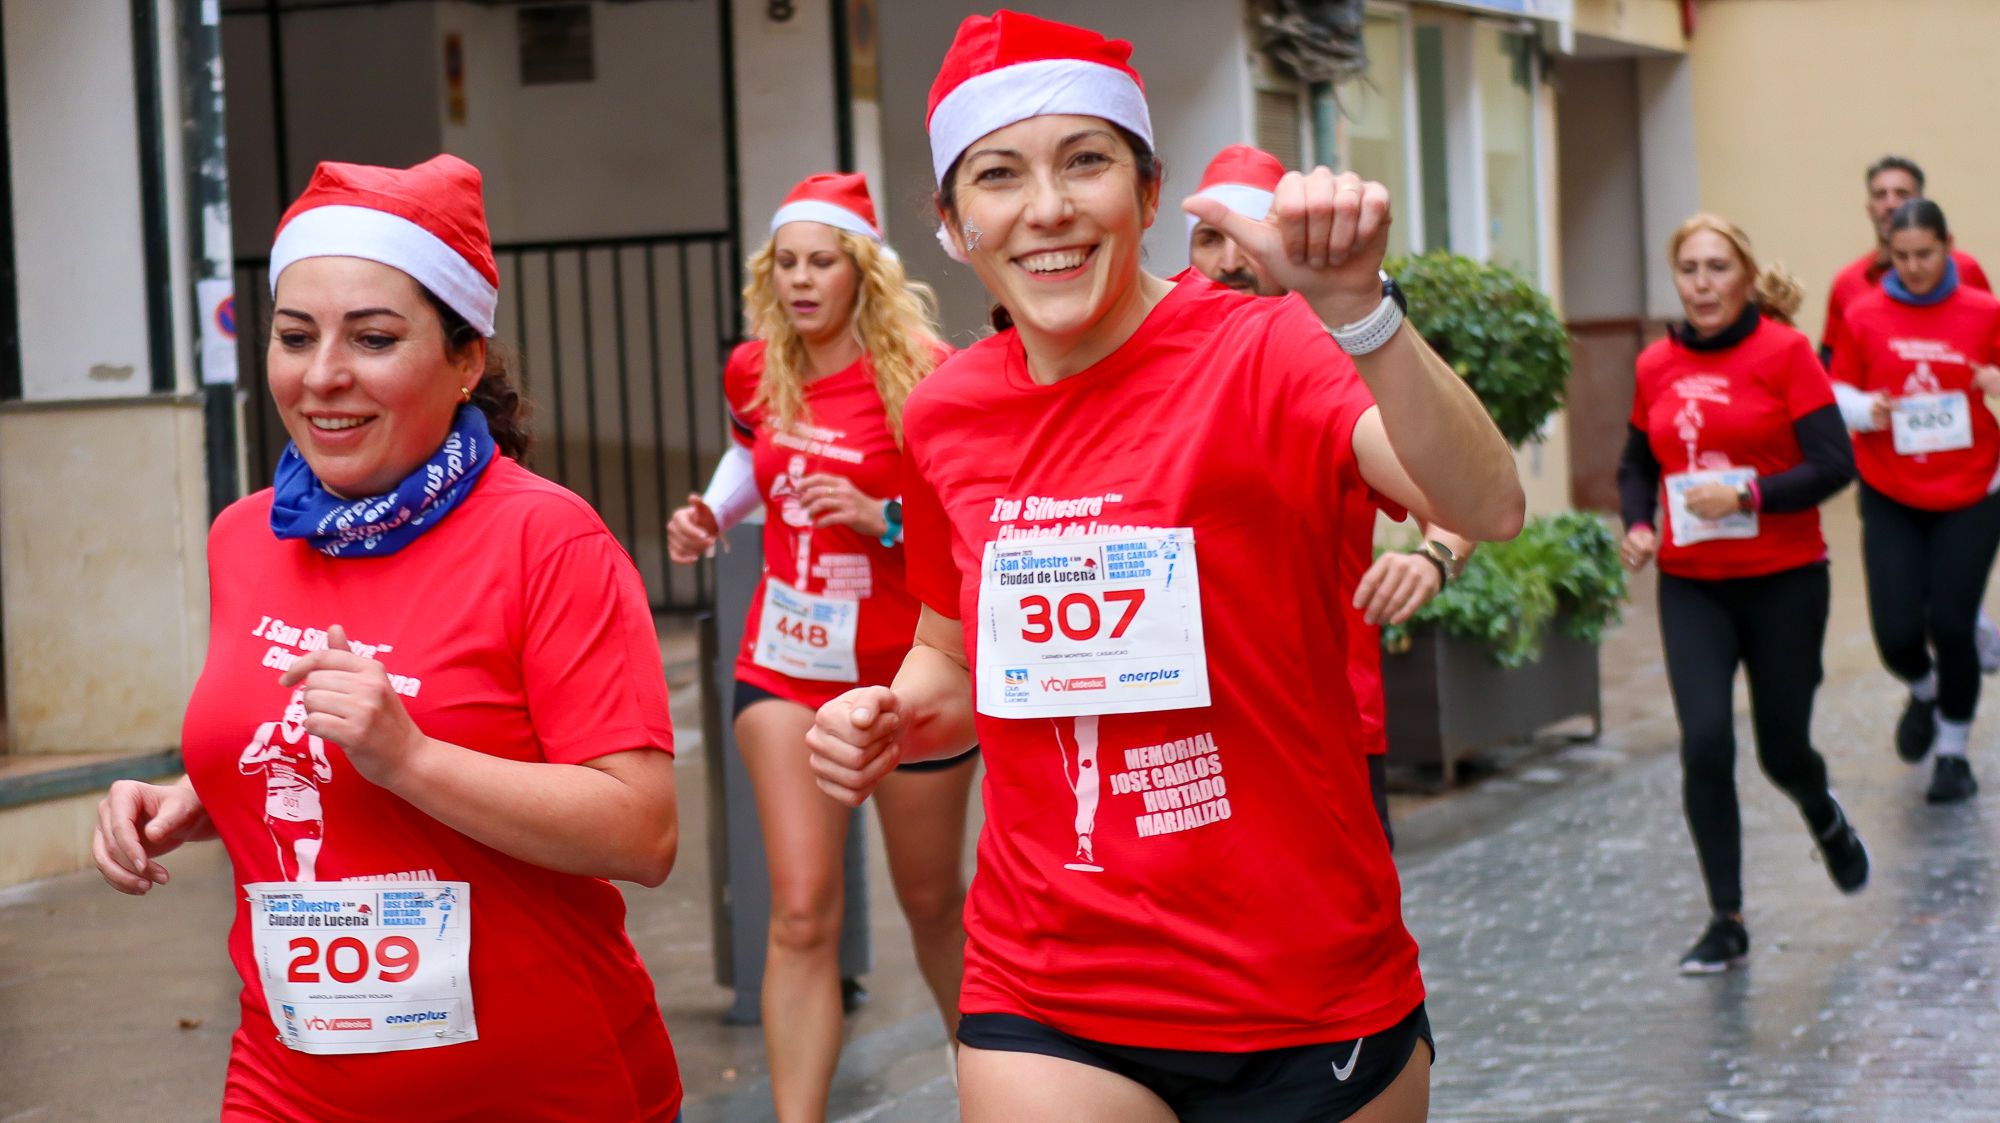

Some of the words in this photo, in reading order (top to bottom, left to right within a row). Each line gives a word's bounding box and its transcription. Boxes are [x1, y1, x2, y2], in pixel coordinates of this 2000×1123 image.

[1022, 496, 1103, 521] Silvestre
[1106, 542, 1147, 552] MEMORIAL
[1107, 553, 1124, 561] JOSE
[1127, 550, 1158, 560] CARLOS
[1000, 559, 1019, 571] San
[1021, 556, 1069, 570] Silvestre
[1108, 560, 1145, 570] HURTADO
[1000, 571, 1034, 585] Ciudad
[1037, 571, 1051, 583] de
[1054, 570, 1096, 583] Lucena
[1109, 569, 1151, 579] MARJALIZO
[1019, 588, 1146, 644] 307
[252, 616, 272, 637] I
[265, 619, 302, 647] San
[776, 616, 829, 648] 448
[1119, 669, 1180, 683] enerplus
[1124, 732, 1218, 770] MEMORIAL
[1110, 769, 1152, 796] JOSE
[1151, 754, 1223, 789] CARLOS
[1143, 775, 1227, 813] HURTADO
[1135, 798, 1232, 838] MARJALIZO
[268, 900, 289, 912] San
[292, 899, 340, 912] Silvestre
[268, 913, 306, 926] Ciudad
[308, 914, 321, 926] de
[324, 914, 369, 926] Lucena
[287, 935, 420, 984] 209
[386, 1010, 448, 1024] enerplus
